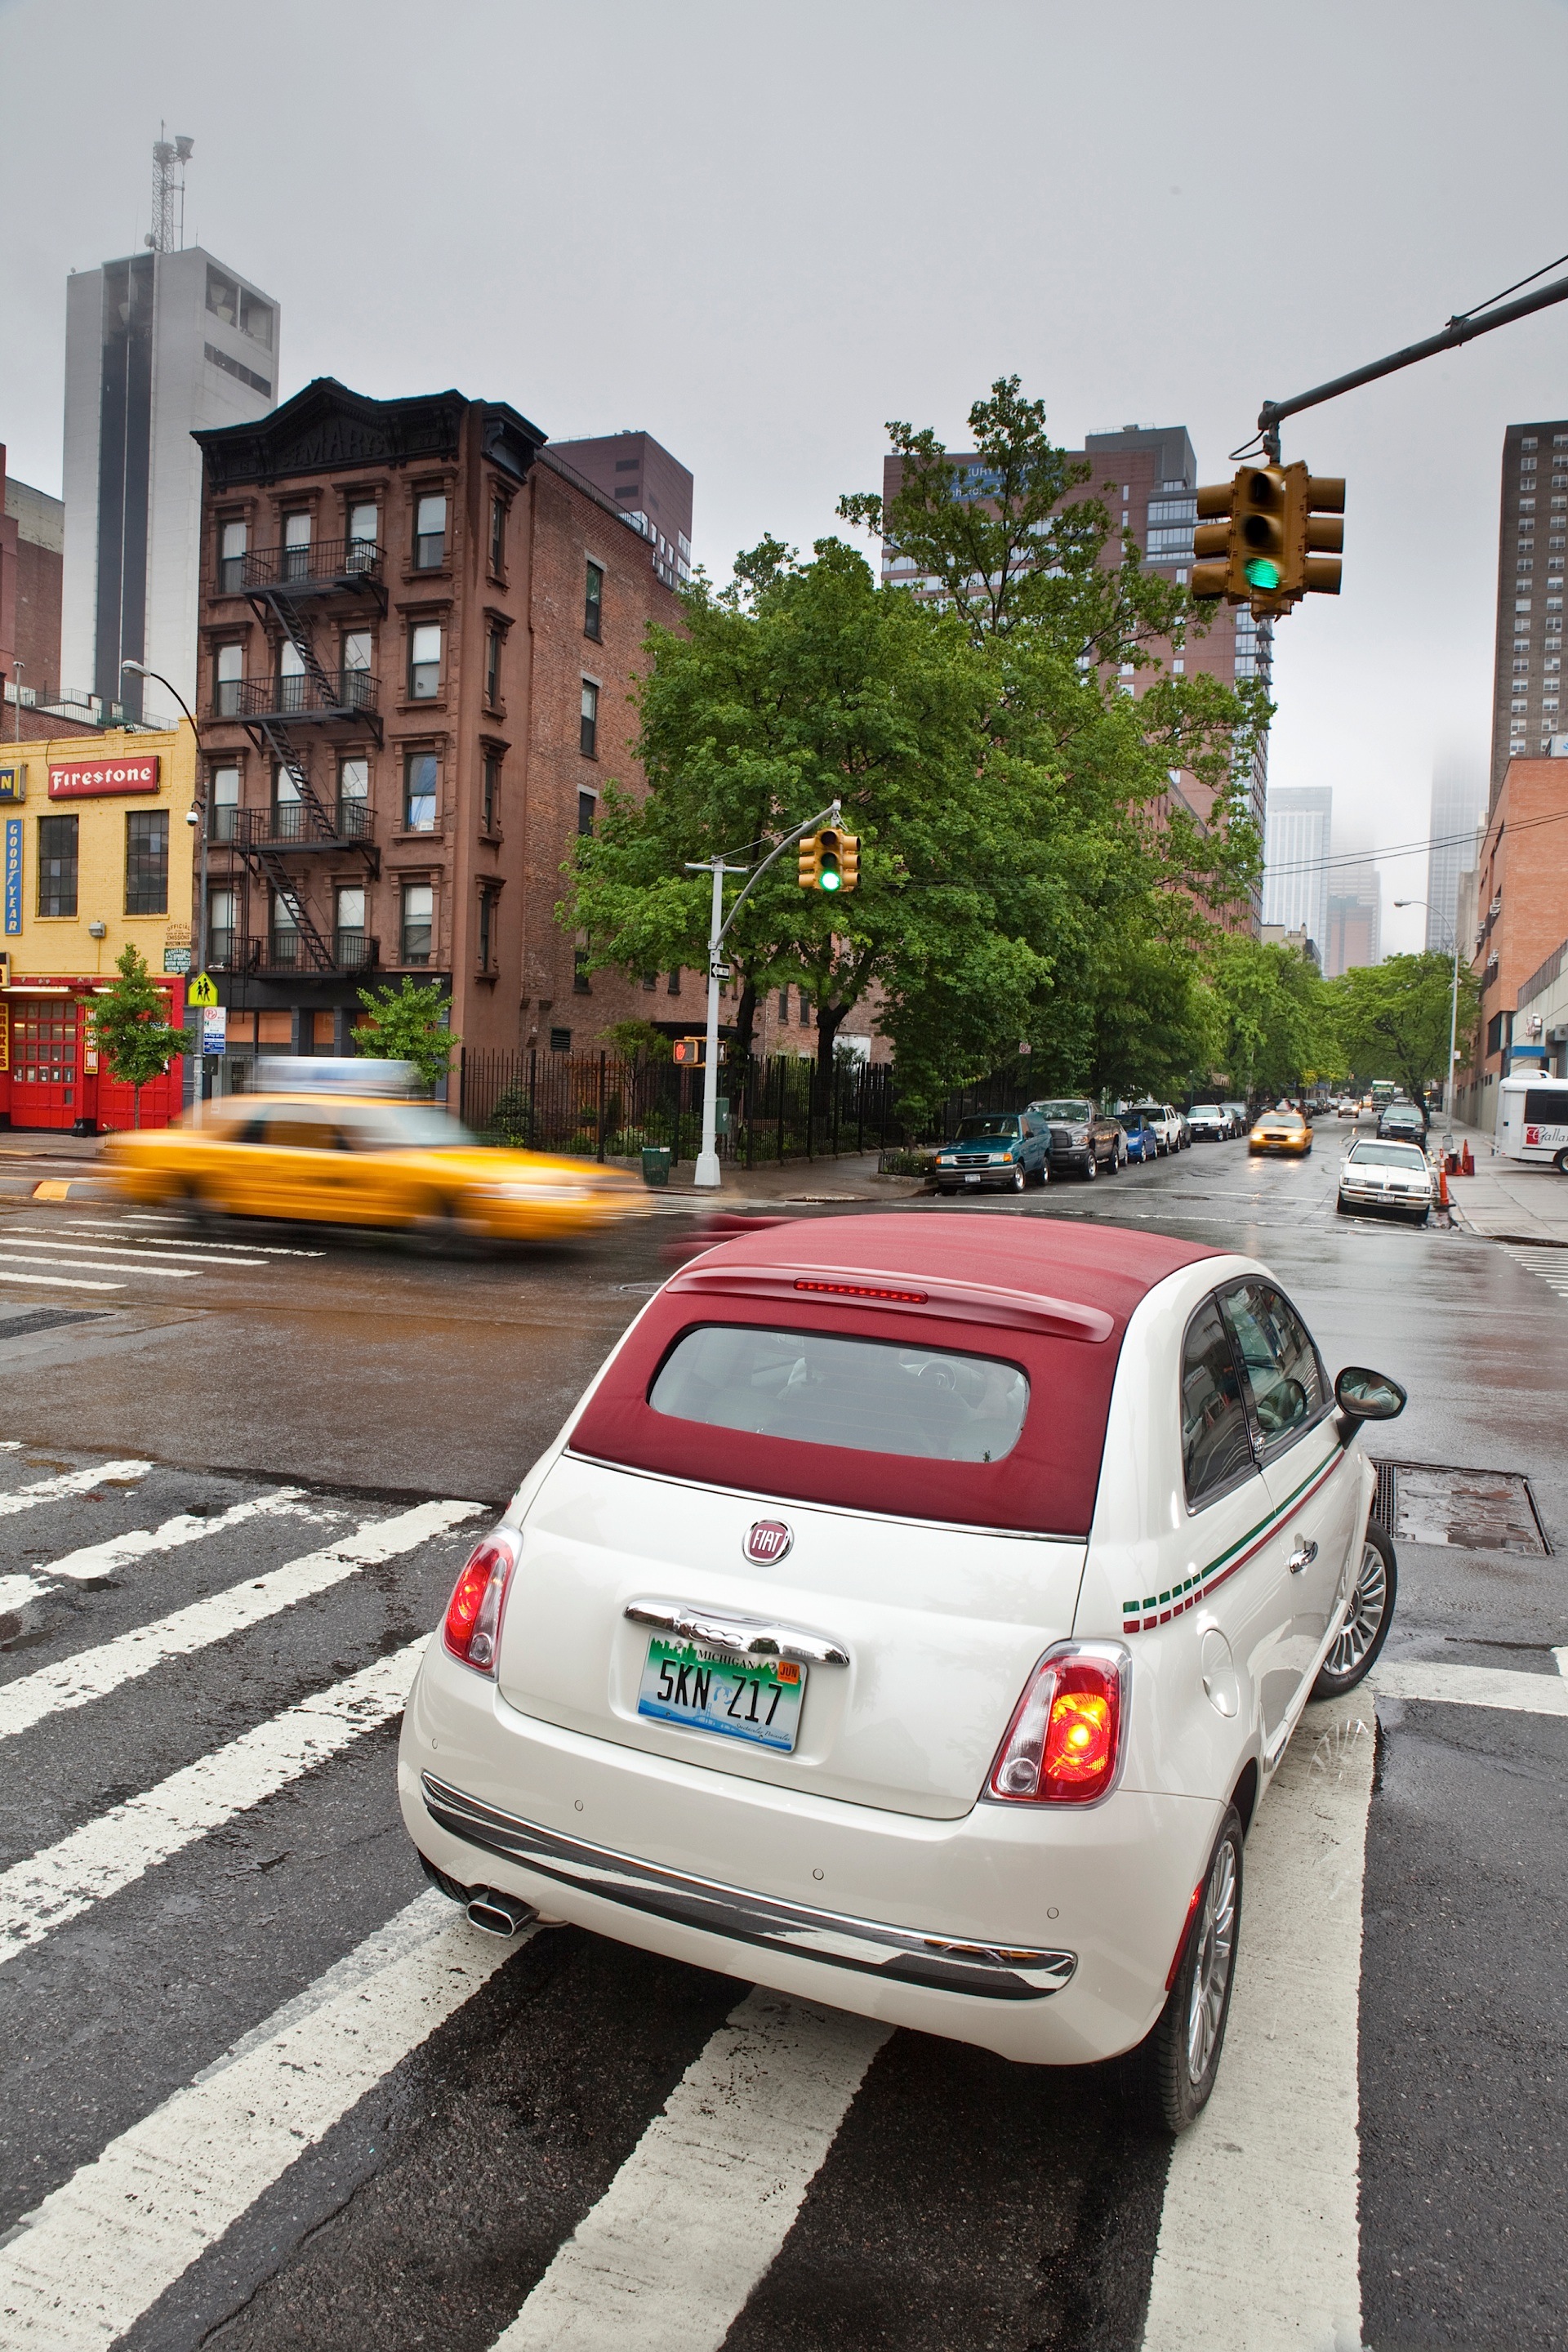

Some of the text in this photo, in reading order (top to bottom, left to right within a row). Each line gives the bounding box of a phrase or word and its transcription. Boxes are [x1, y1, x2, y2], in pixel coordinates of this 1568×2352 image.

[51, 767, 152, 791] Firestone
[167, 924, 190, 932] OFFICIAL
[751, 1529, 783, 1552] FIAT
[688, 1622, 744, 1649] 500
[697, 1649, 756, 1670] MICHIGAN
[780, 1665, 797, 1678] JUN
[657, 1658, 783, 1726] 5KN Z17
[736, 1722, 764, 1735] Spectacular
